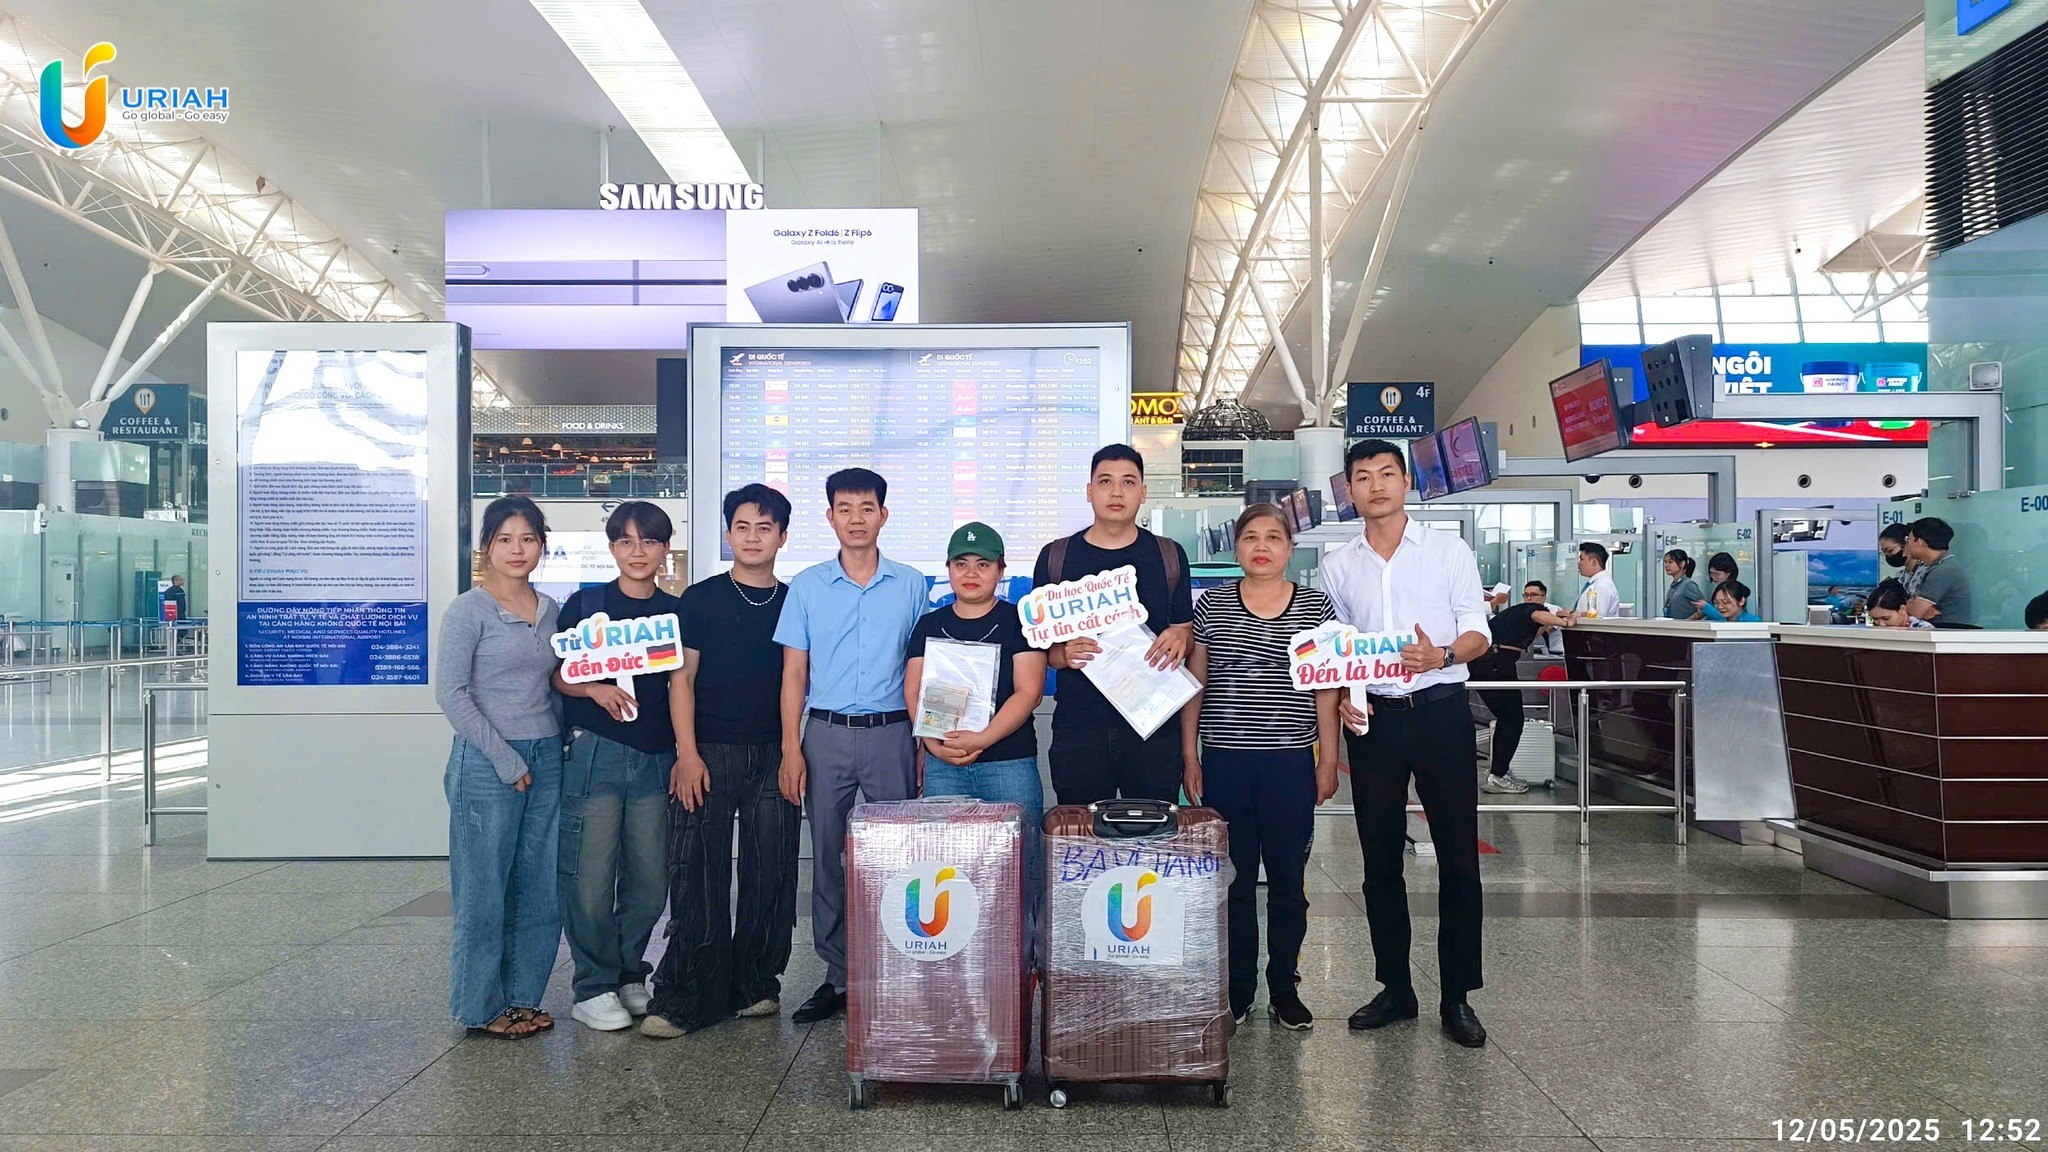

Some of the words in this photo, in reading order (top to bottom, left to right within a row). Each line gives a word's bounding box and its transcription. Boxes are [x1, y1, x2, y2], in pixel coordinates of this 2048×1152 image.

[600, 182, 764, 210] SAMSUNG
[773, 229, 806, 238] Galaxy
[808, 229, 813, 237] Z
[815, 229, 839, 237] Fold6
[844, 229, 850, 237] Z
[851, 229, 872, 238] Flip6
[1712, 350, 1772, 375] NGÔI
[1416, 386, 1431, 398] 4F
[120, 417, 160, 426] COFFEE
[164, 417, 171, 426] &
[561, 422, 585, 430] FOOD
[594, 422, 624, 430] DRINKS
[1364, 416, 1404, 424] COFFEE
[1409, 416, 1416, 424] &
[112, 426, 179, 435] RESTAURANT
[1356, 425, 1424, 433] RESTAURANT
[2021, 495, 2048, 512] E-00
[1883, 510, 1903, 524] E-01
[1737, 528, 1752, 540] E-02
[1045, 589, 1062, 602] Du
[1063, 585, 1083, 600] học
[1084, 576, 1112, 593] Quốc
[1114, 571, 1130, 586] Tế
[1049, 586, 1132, 620] URIAH
[394, 606, 406, 614] TIN
[1028, 627, 1050, 644] Tự
[1053, 621, 1074, 638] tin
[1078, 612, 1102, 631] cất
[557, 633, 582, 652] Từ
[583, 618, 675, 649] URIAH
[1335, 631, 1413, 658] URIAH
[567, 653, 603, 678] đến
[605, 652, 644, 672] Đức
[1296, 658, 1341, 685] Đến
[1346, 659, 1368, 681] là
[905, 941, 947, 950] URIAH
[1108, 945, 1150, 954] URIAH
